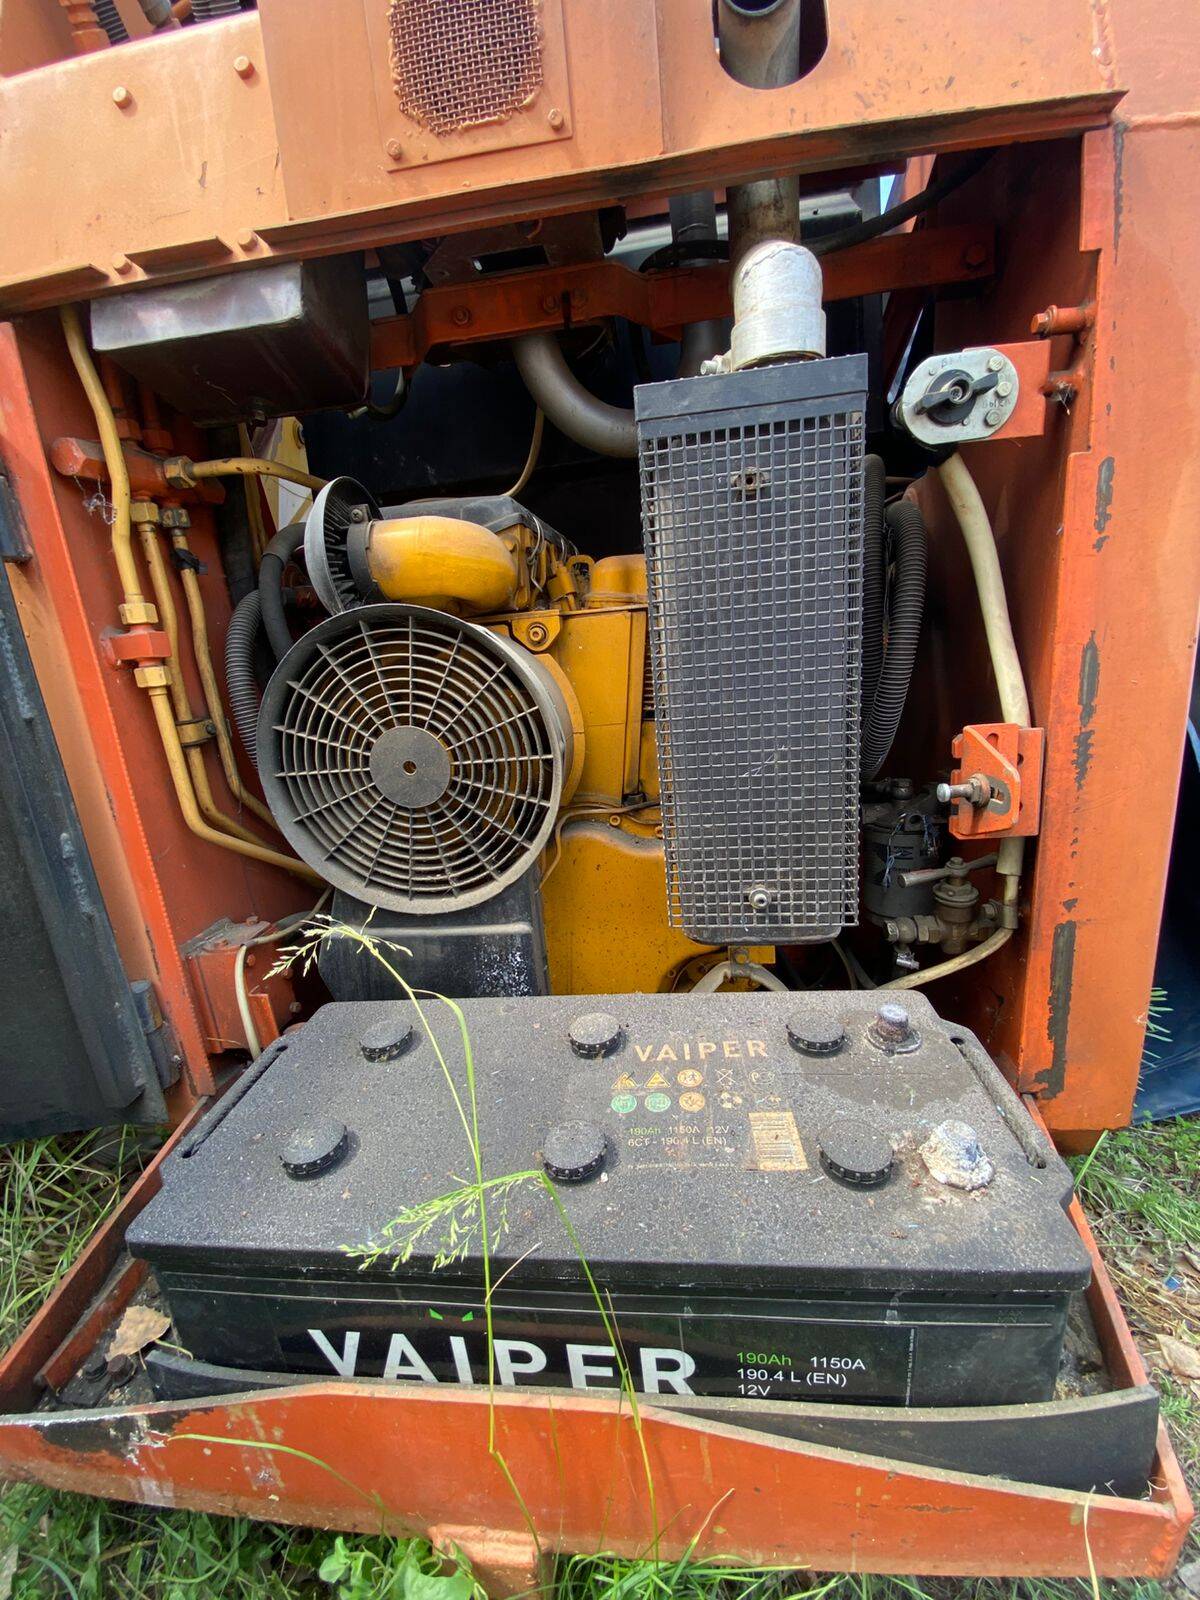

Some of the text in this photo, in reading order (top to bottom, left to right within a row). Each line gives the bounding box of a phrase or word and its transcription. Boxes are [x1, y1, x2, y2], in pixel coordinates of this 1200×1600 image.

[634, 1040, 769, 1062] VAIPER
[668, 1125, 701, 1134] 1150A
[710, 1125, 730, 1134] 12V
[702, 1136, 727, 1146] (EN)
[307, 1328, 697, 1395] VAIPER
[736, 1351, 866, 1370] 190Ah 1150A
[737, 1368, 847, 1387] 190.4 L (EN)
[738, 1384, 771, 1396] 12V
